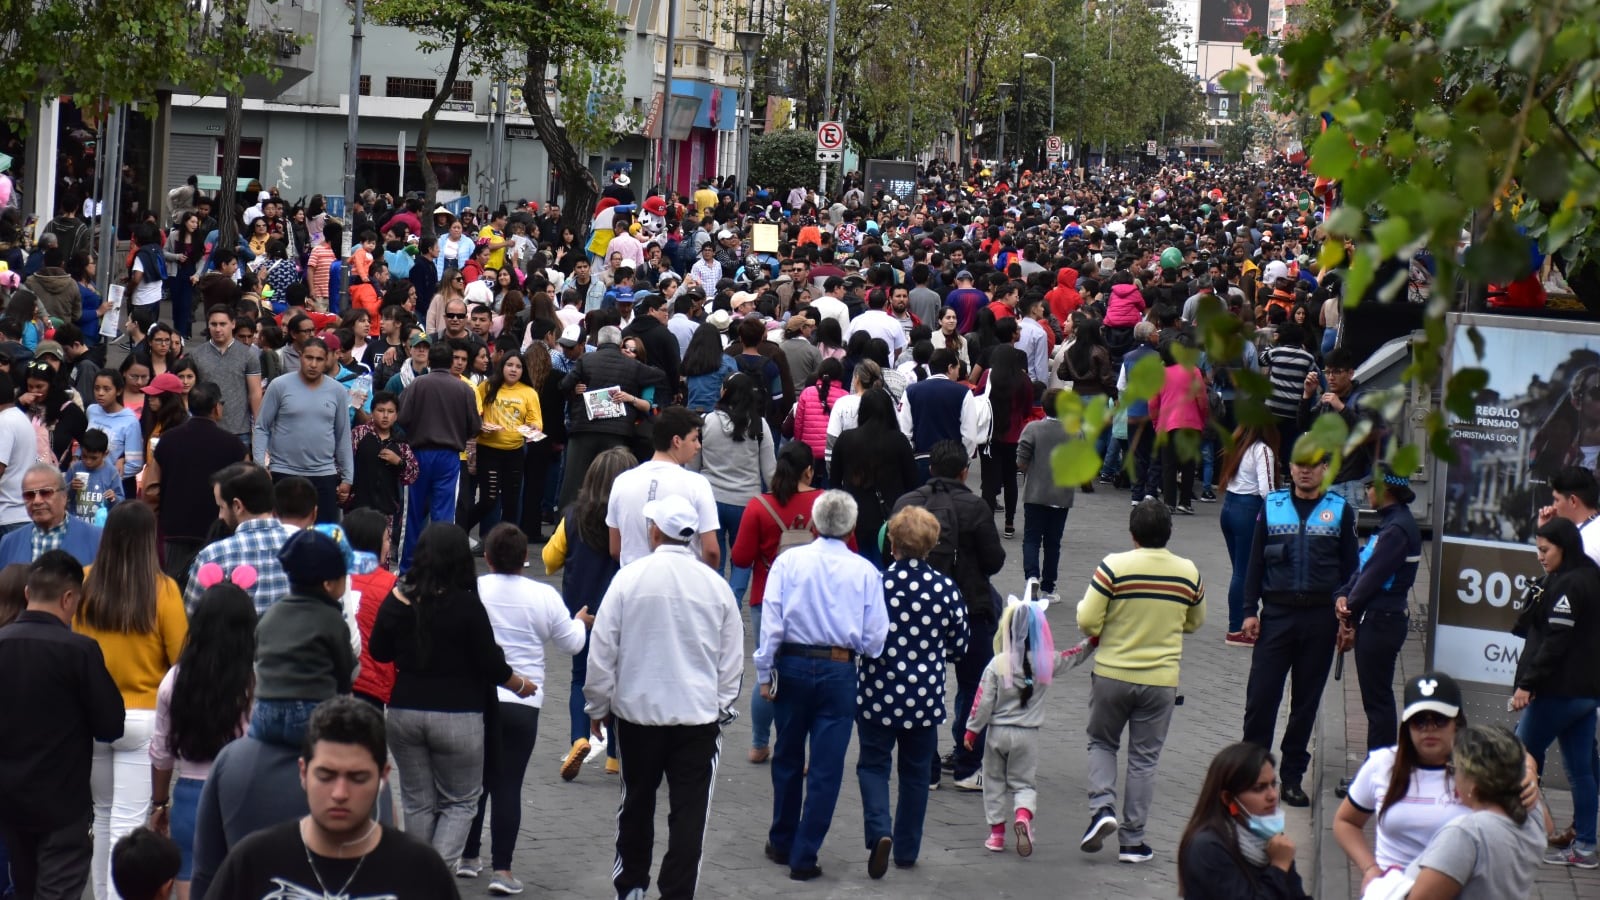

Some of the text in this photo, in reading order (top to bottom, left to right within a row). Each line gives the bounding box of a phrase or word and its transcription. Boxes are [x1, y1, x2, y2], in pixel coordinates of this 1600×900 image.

[1475, 405, 1520, 419] REGALO
[1477, 418, 1519, 429] PENSADO
[1454, 430, 1519, 443] CHRISTMAS LOOK
[79, 491, 103, 502] NEED
